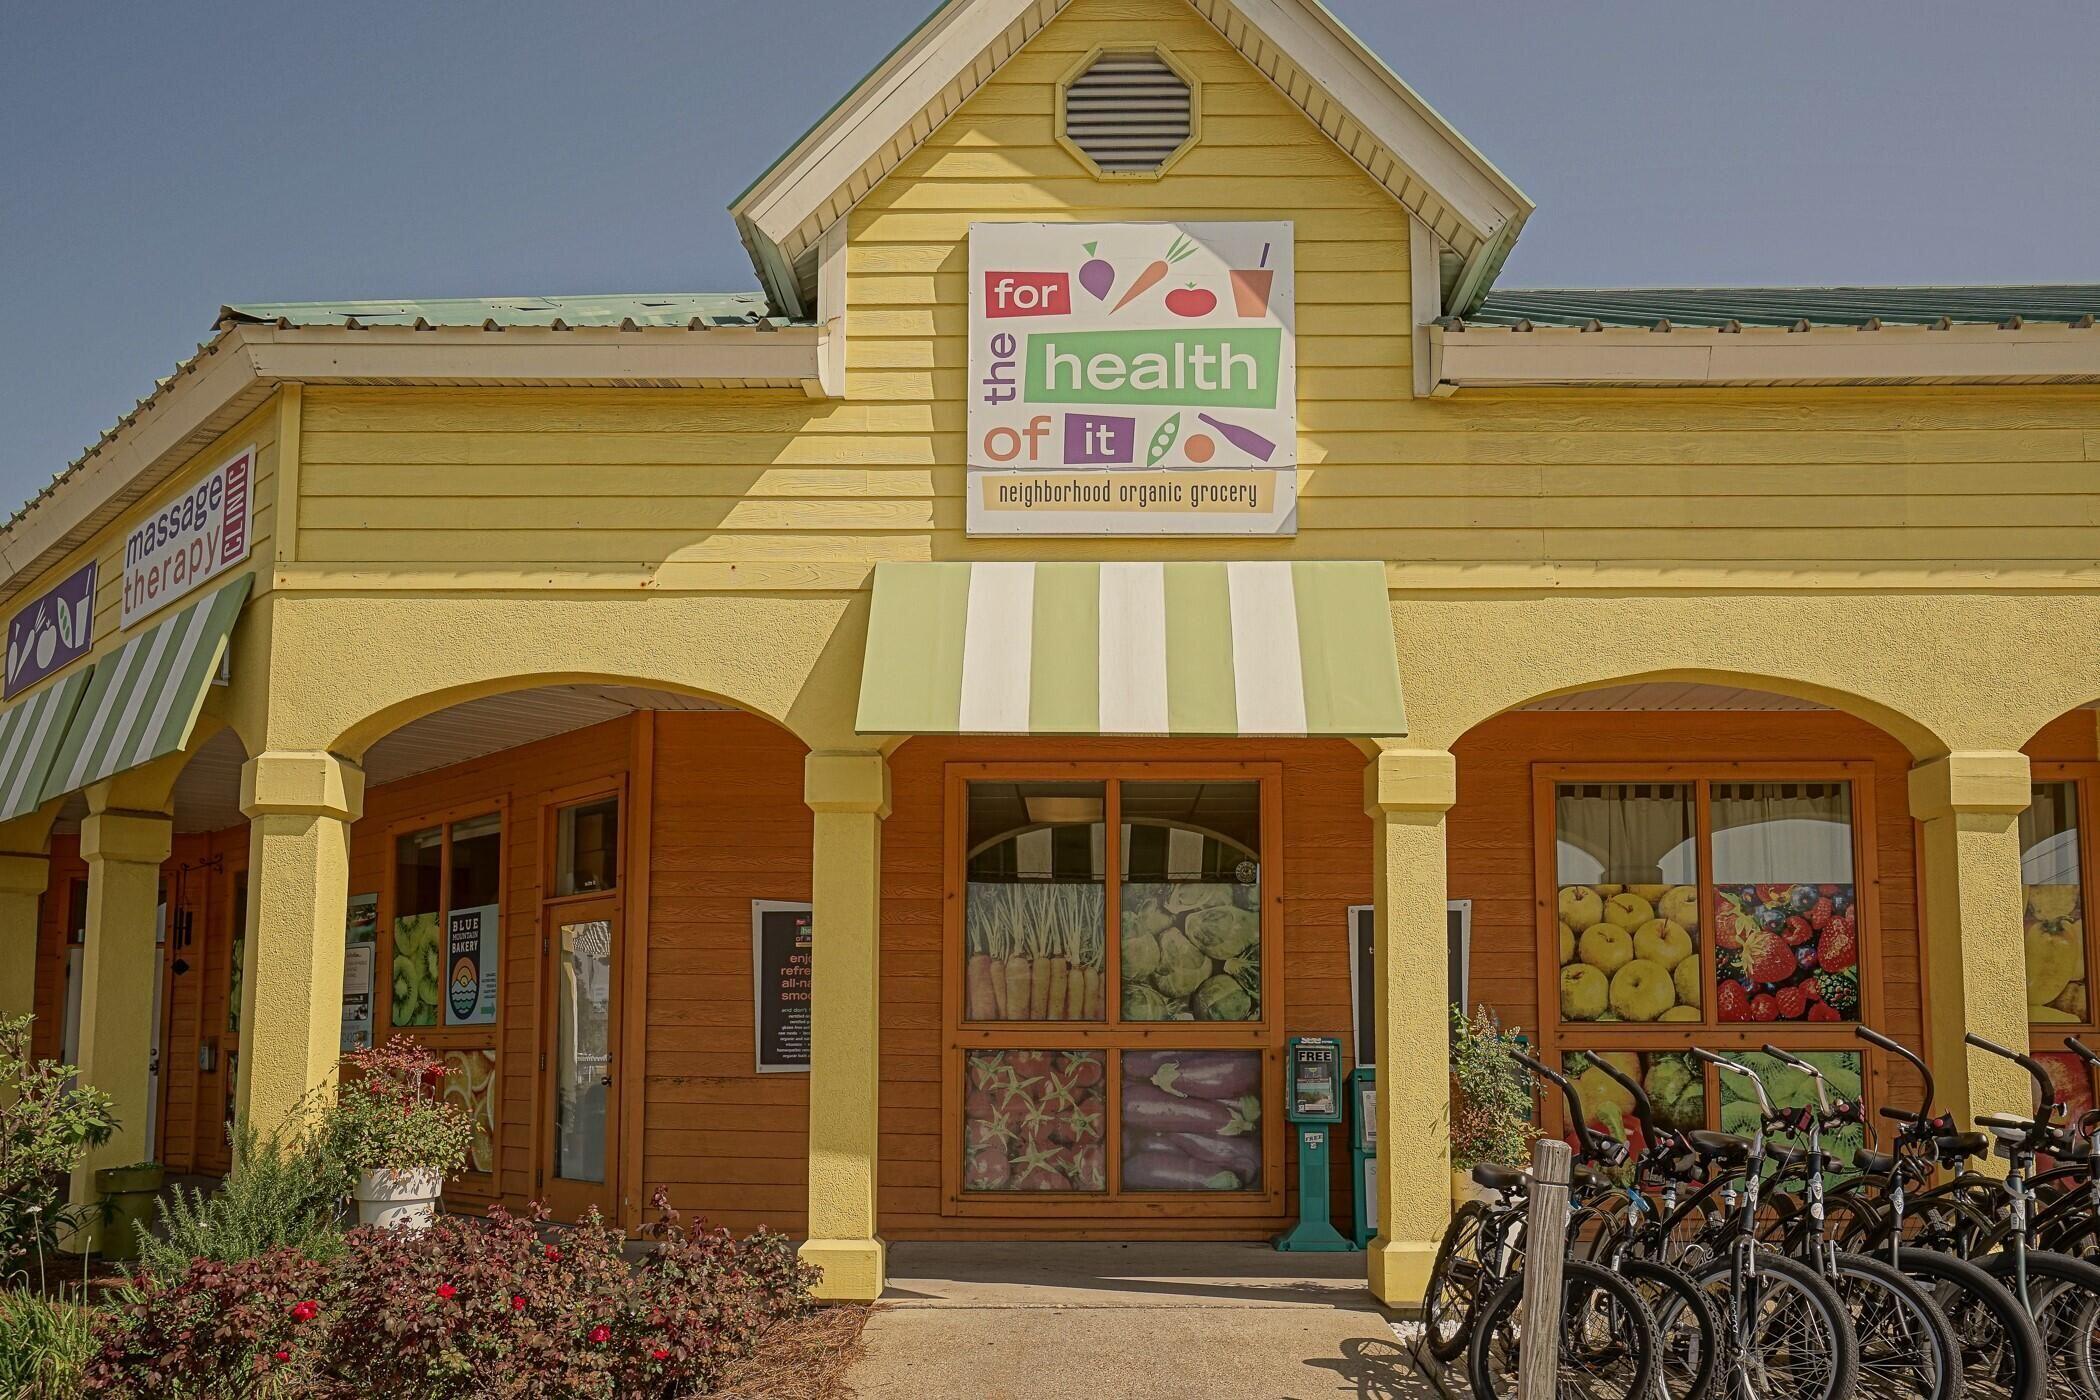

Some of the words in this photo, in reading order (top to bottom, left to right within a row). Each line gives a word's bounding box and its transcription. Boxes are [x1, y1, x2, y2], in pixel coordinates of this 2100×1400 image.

[994, 278, 1058, 309] for
[983, 332, 1017, 406] the
[1045, 342, 1258, 391] health
[984, 415, 1052, 462] of
[1085, 422, 1115, 456] it
[223, 463, 246, 557] CLINIC
[999, 480, 1111, 508] neighborhood
[1119, 483, 1182, 508] organic
[1190, 486, 1257, 508] grocery
[126, 474, 223, 569] massage
[123, 524, 222, 616] therapy
[452, 918, 479, 932] BLUE
[452, 940, 479, 954] BAKERY
[1299, 1051, 1331, 1061] FREE
